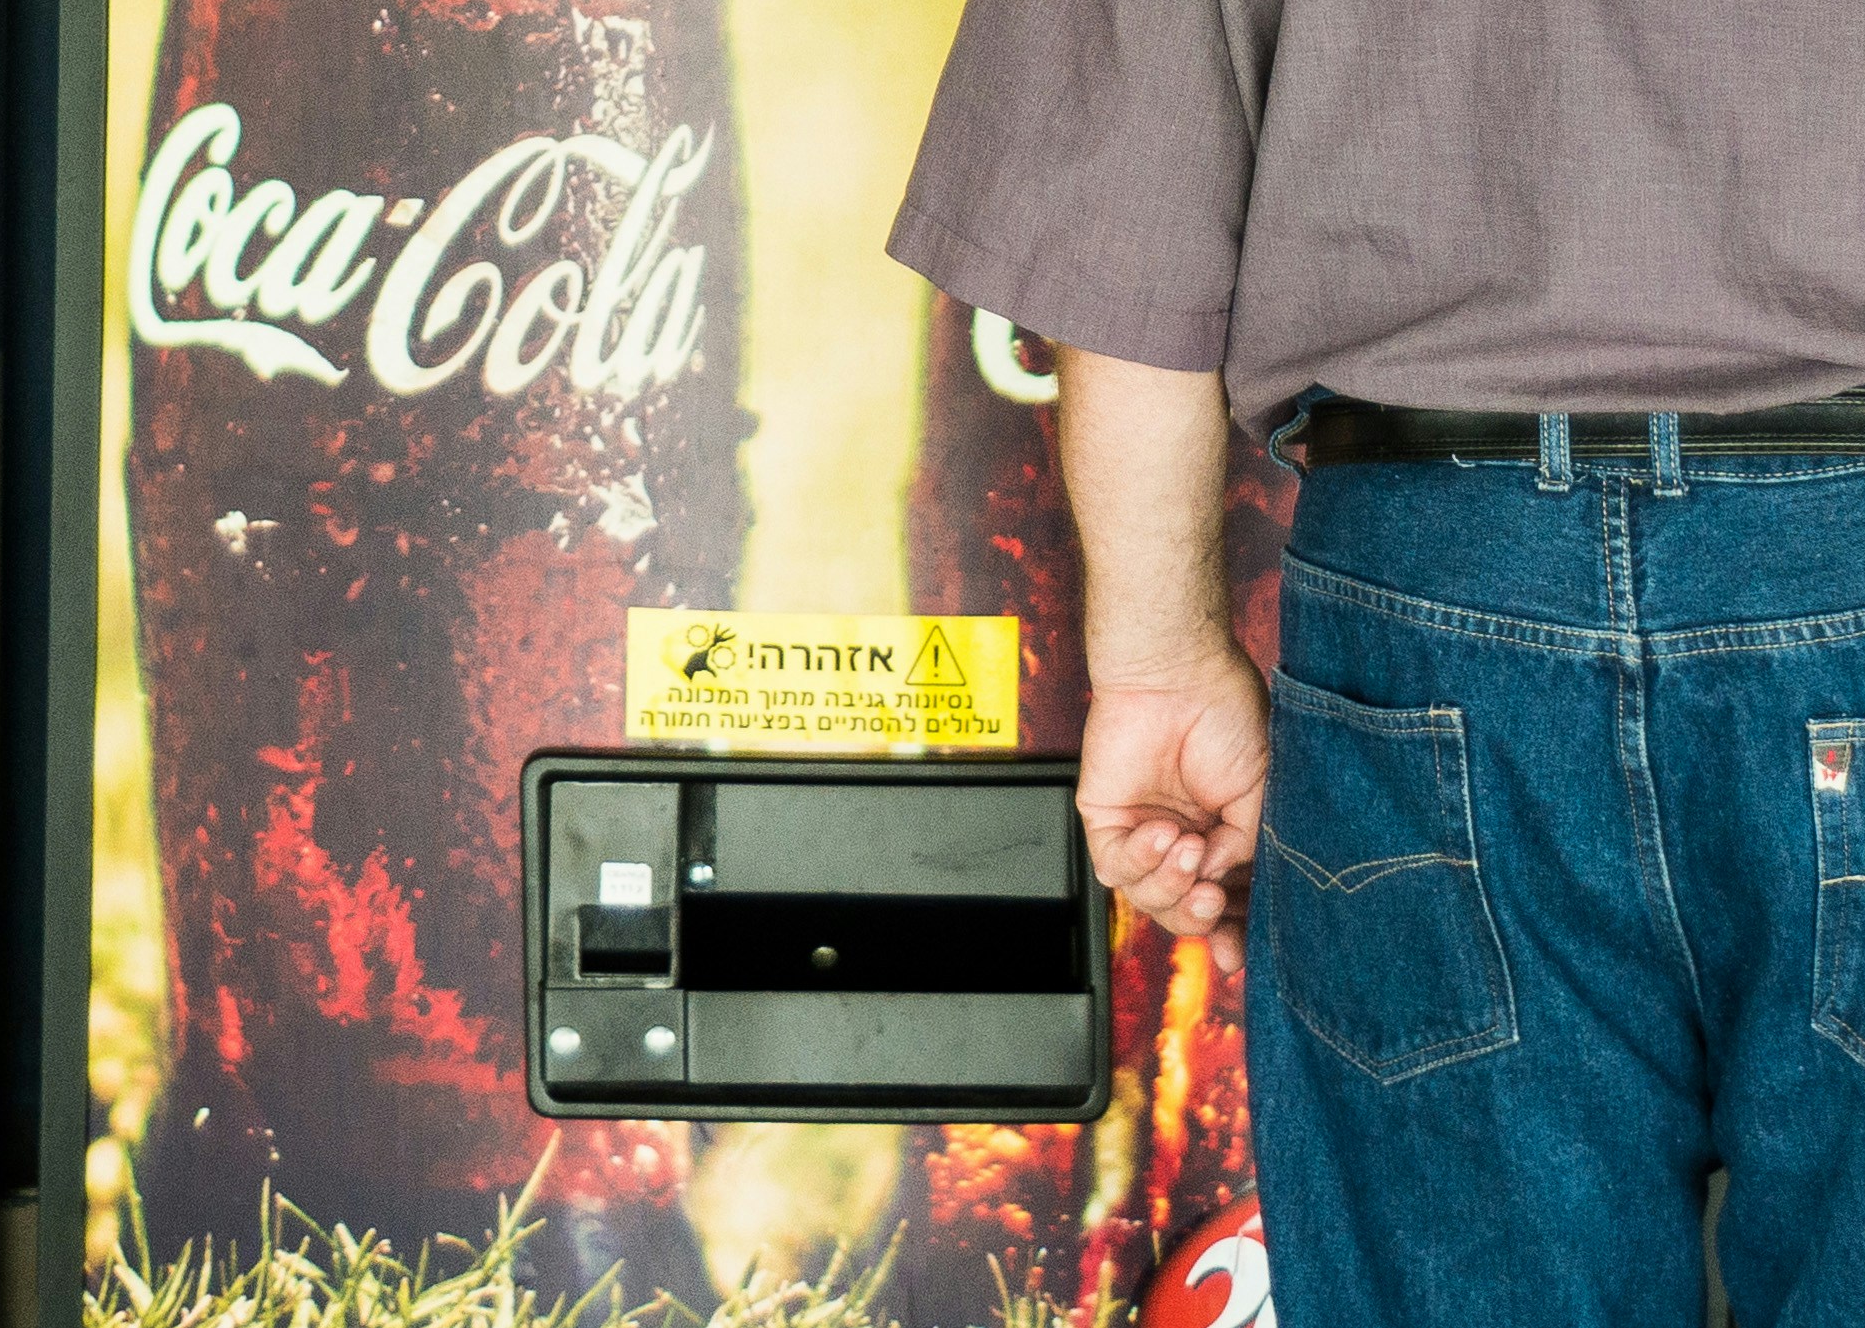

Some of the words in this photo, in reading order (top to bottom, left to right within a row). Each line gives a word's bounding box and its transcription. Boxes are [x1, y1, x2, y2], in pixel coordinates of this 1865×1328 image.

[128, 103, 715, 396] Coca-Cola
[748, 644, 895, 673] אזהרה!
[668, 687, 749, 705] המכונה
[758, 688, 814, 712] מתוך
[825, 690, 885, 709] גניבה
[896, 691, 973, 710] נסיונות
[641, 709, 710, 728] חמורה
[720, 711, 807, 732] בפציעה
[818, 711, 917, 734] להסתיים
[926, 713, 1001, 734] עלולים
